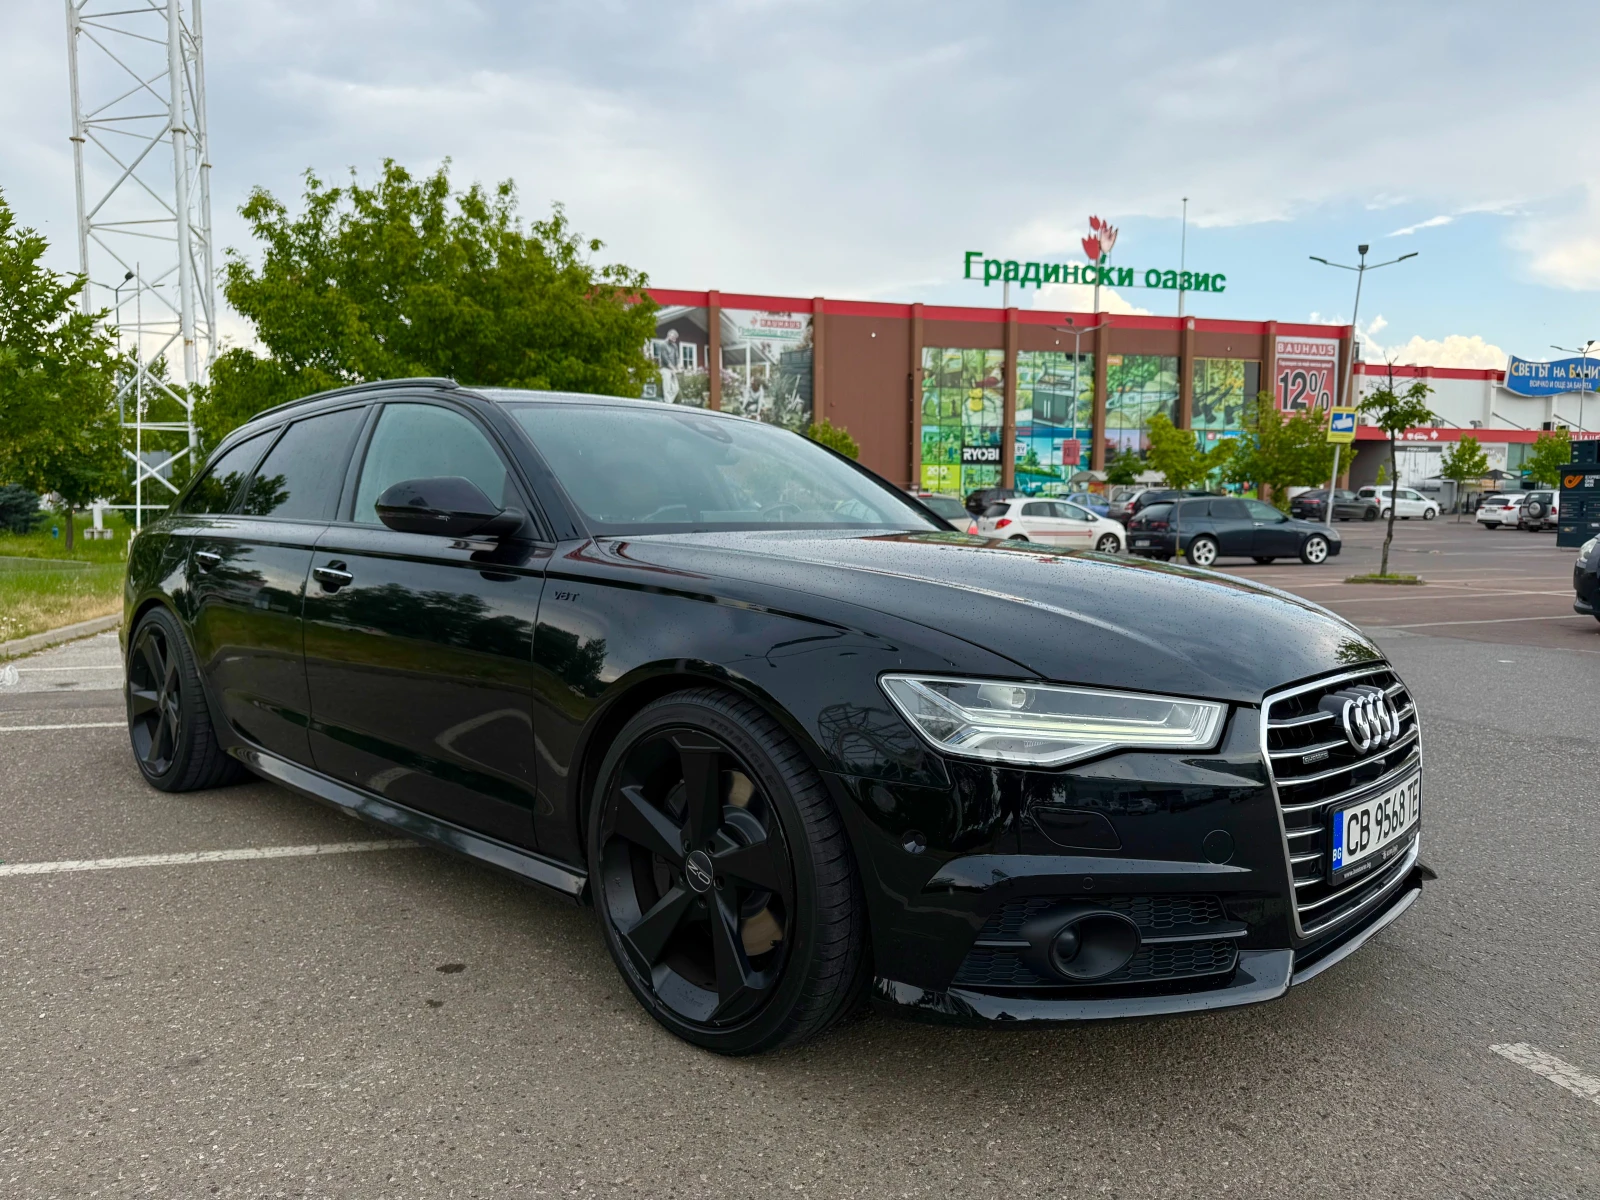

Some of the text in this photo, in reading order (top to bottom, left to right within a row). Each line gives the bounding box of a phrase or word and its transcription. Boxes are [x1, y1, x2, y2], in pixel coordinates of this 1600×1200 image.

[964, 251, 1227, 292] Градински оазис
[1277, 343, 1334, 355] BAUHAUS
[1553, 366, 1566, 378] НА
[1569, 363, 1600, 379] БАНИ
[1279, 369, 1331, 413] 12%
[1529, 380, 1549, 388] ВСИЧКО
[962, 447, 1000, 461] RYOBI
[1347, 778, 1419, 856] CB 9568 TE
[1332, 847, 1342, 861] BG
